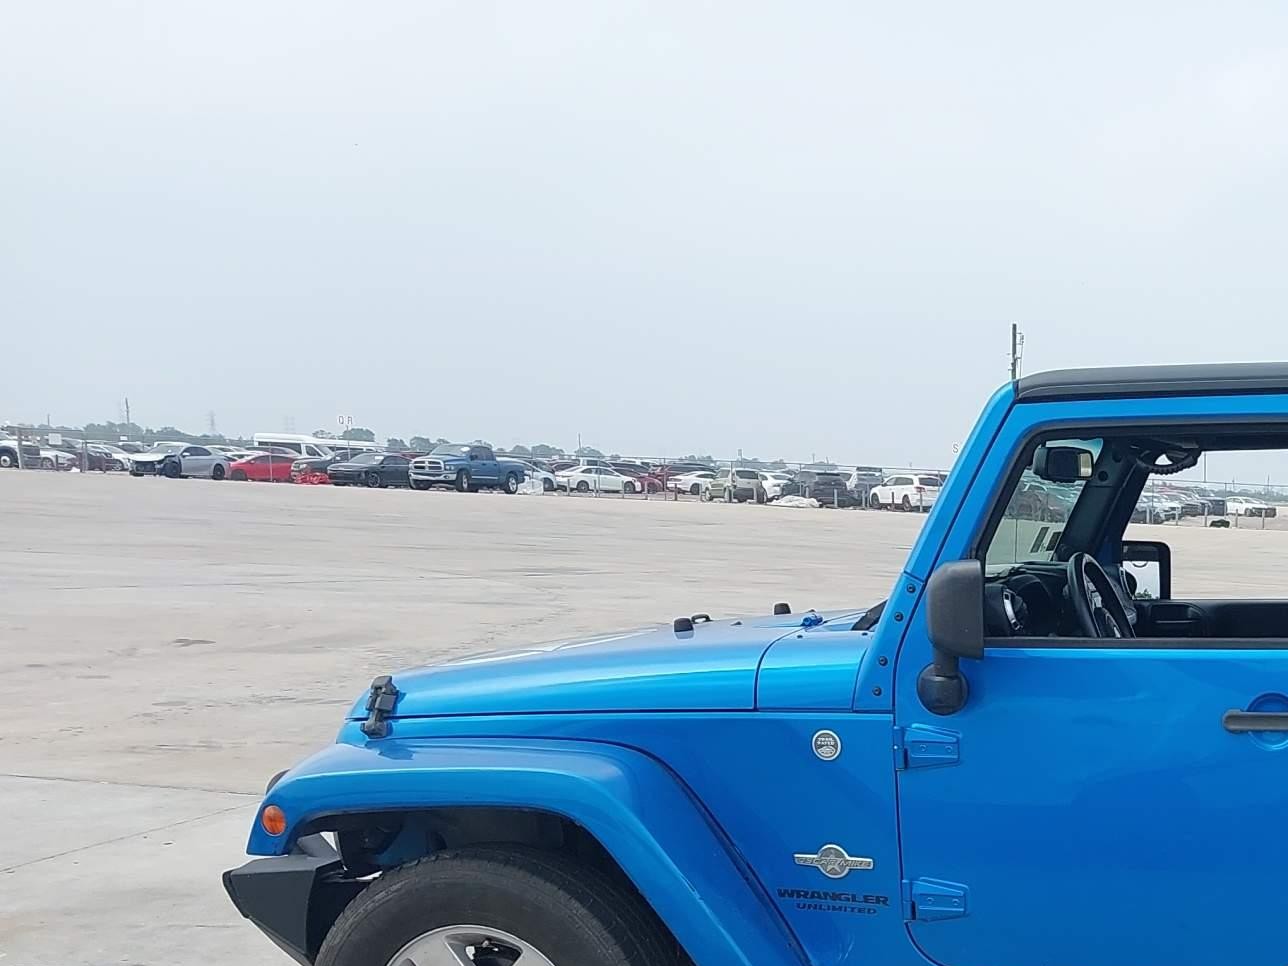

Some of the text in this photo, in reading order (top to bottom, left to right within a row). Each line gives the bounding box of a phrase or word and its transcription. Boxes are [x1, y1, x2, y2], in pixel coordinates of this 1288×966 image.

[952, 443, 959, 454] S
[777, 889, 889, 906] WRANGLER
[796, 903, 877, 915] UNLIMITED
